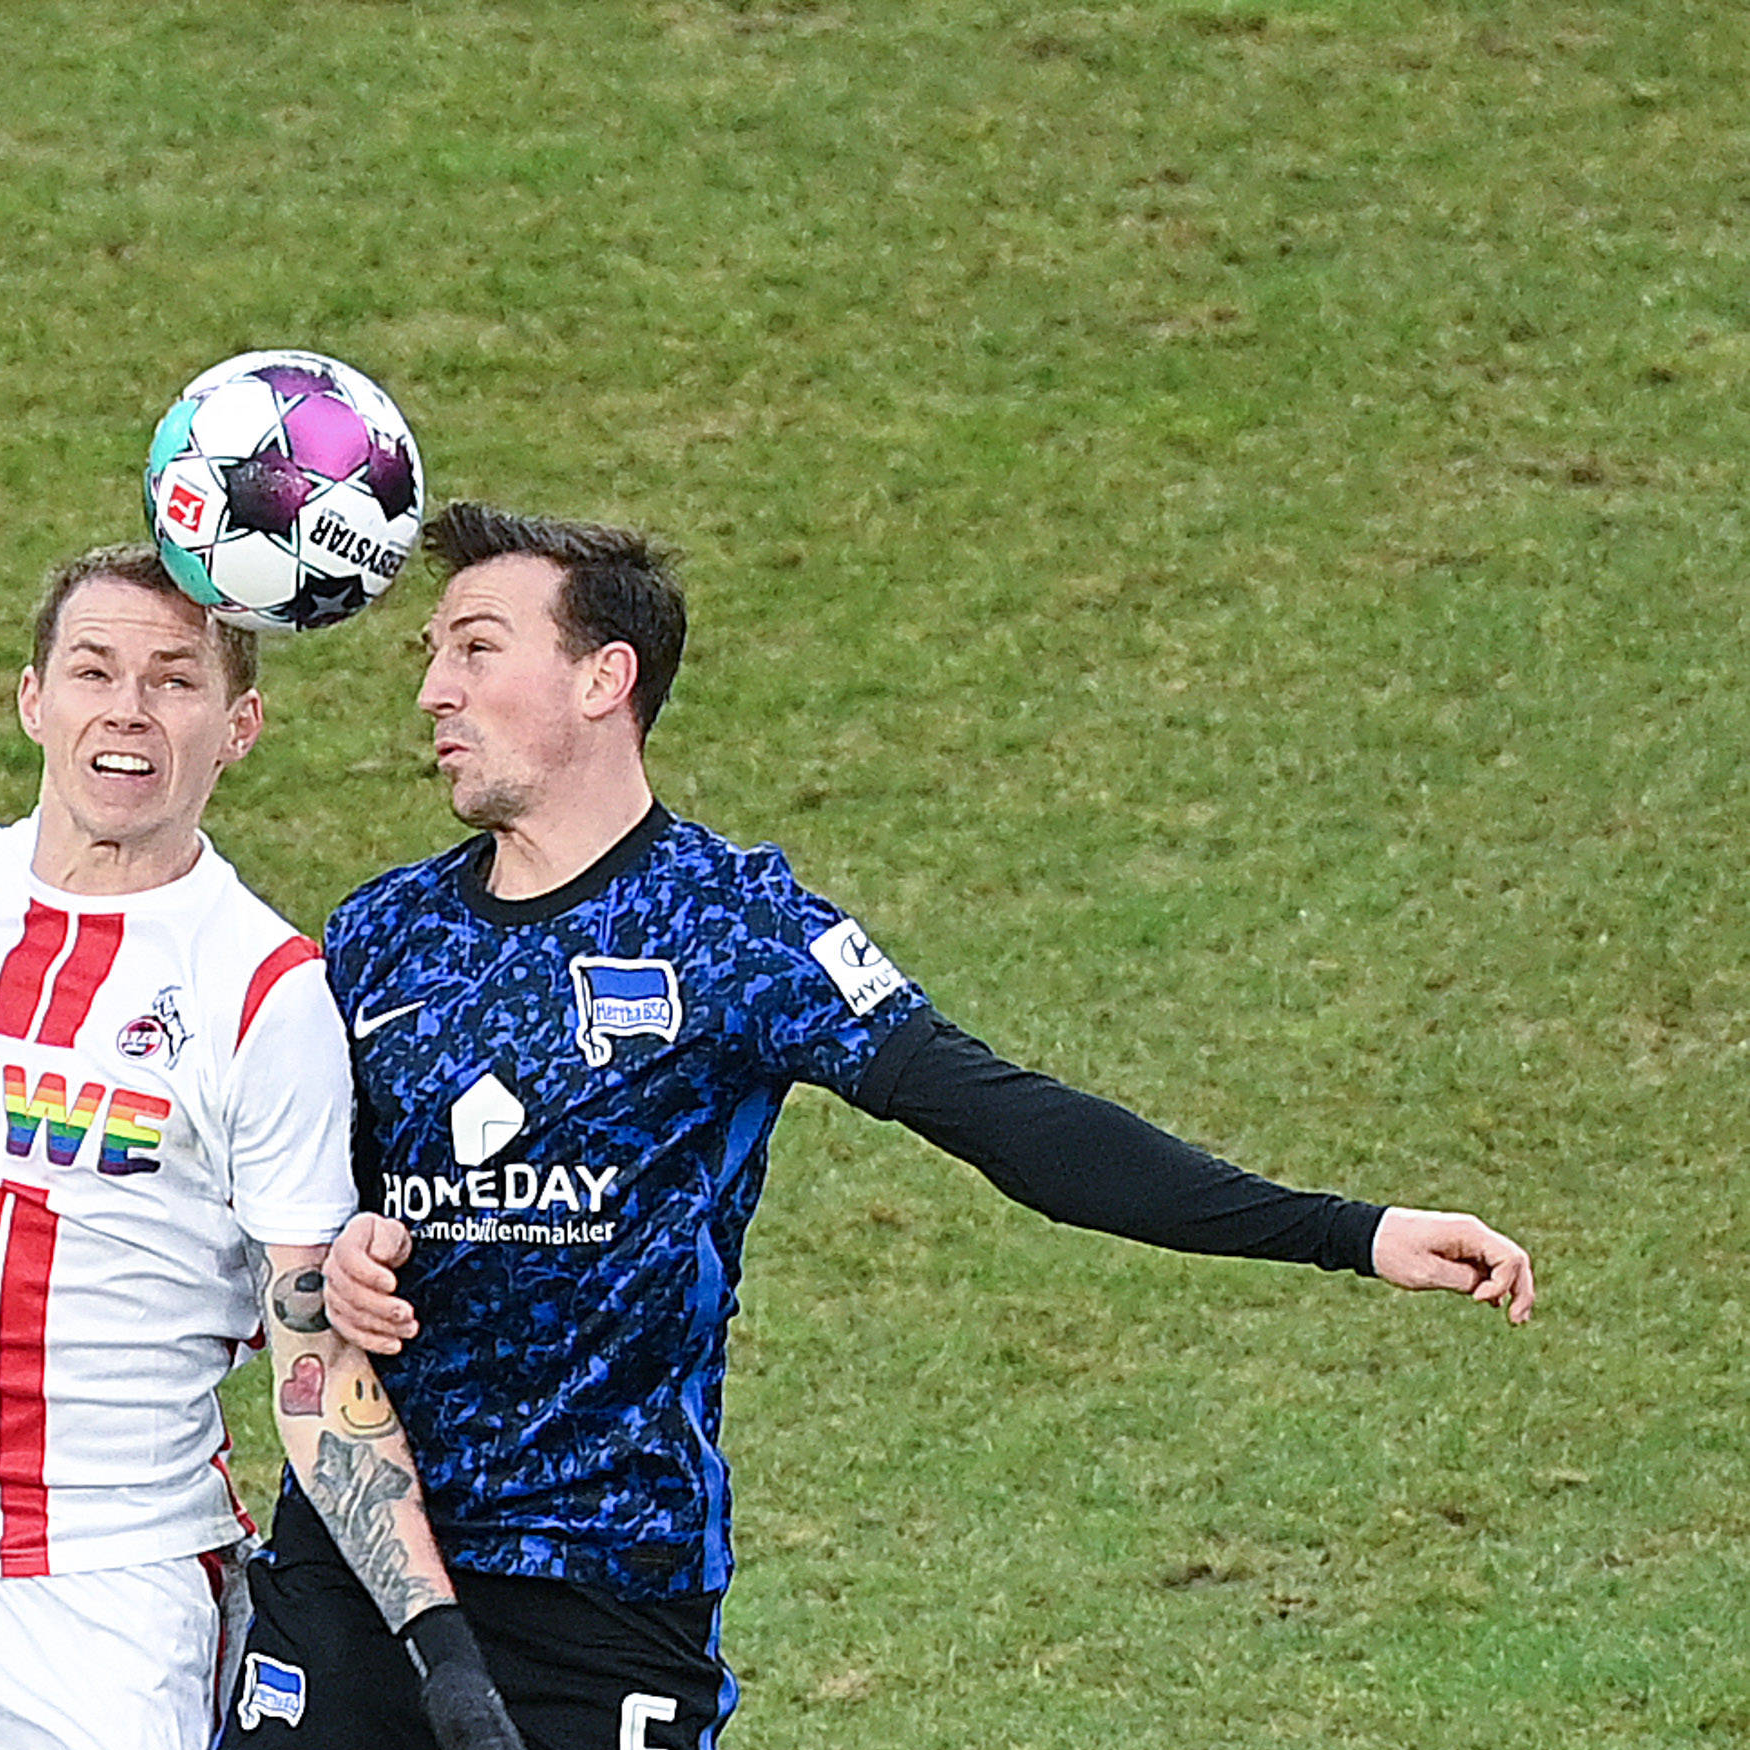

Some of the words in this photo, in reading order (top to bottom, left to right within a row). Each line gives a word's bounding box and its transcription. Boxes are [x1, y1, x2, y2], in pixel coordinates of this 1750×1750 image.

[849, 968, 891, 1007] HYU
[643, 1002, 667, 1021] BSC
[383, 1163, 619, 1221] HOMEDAY
